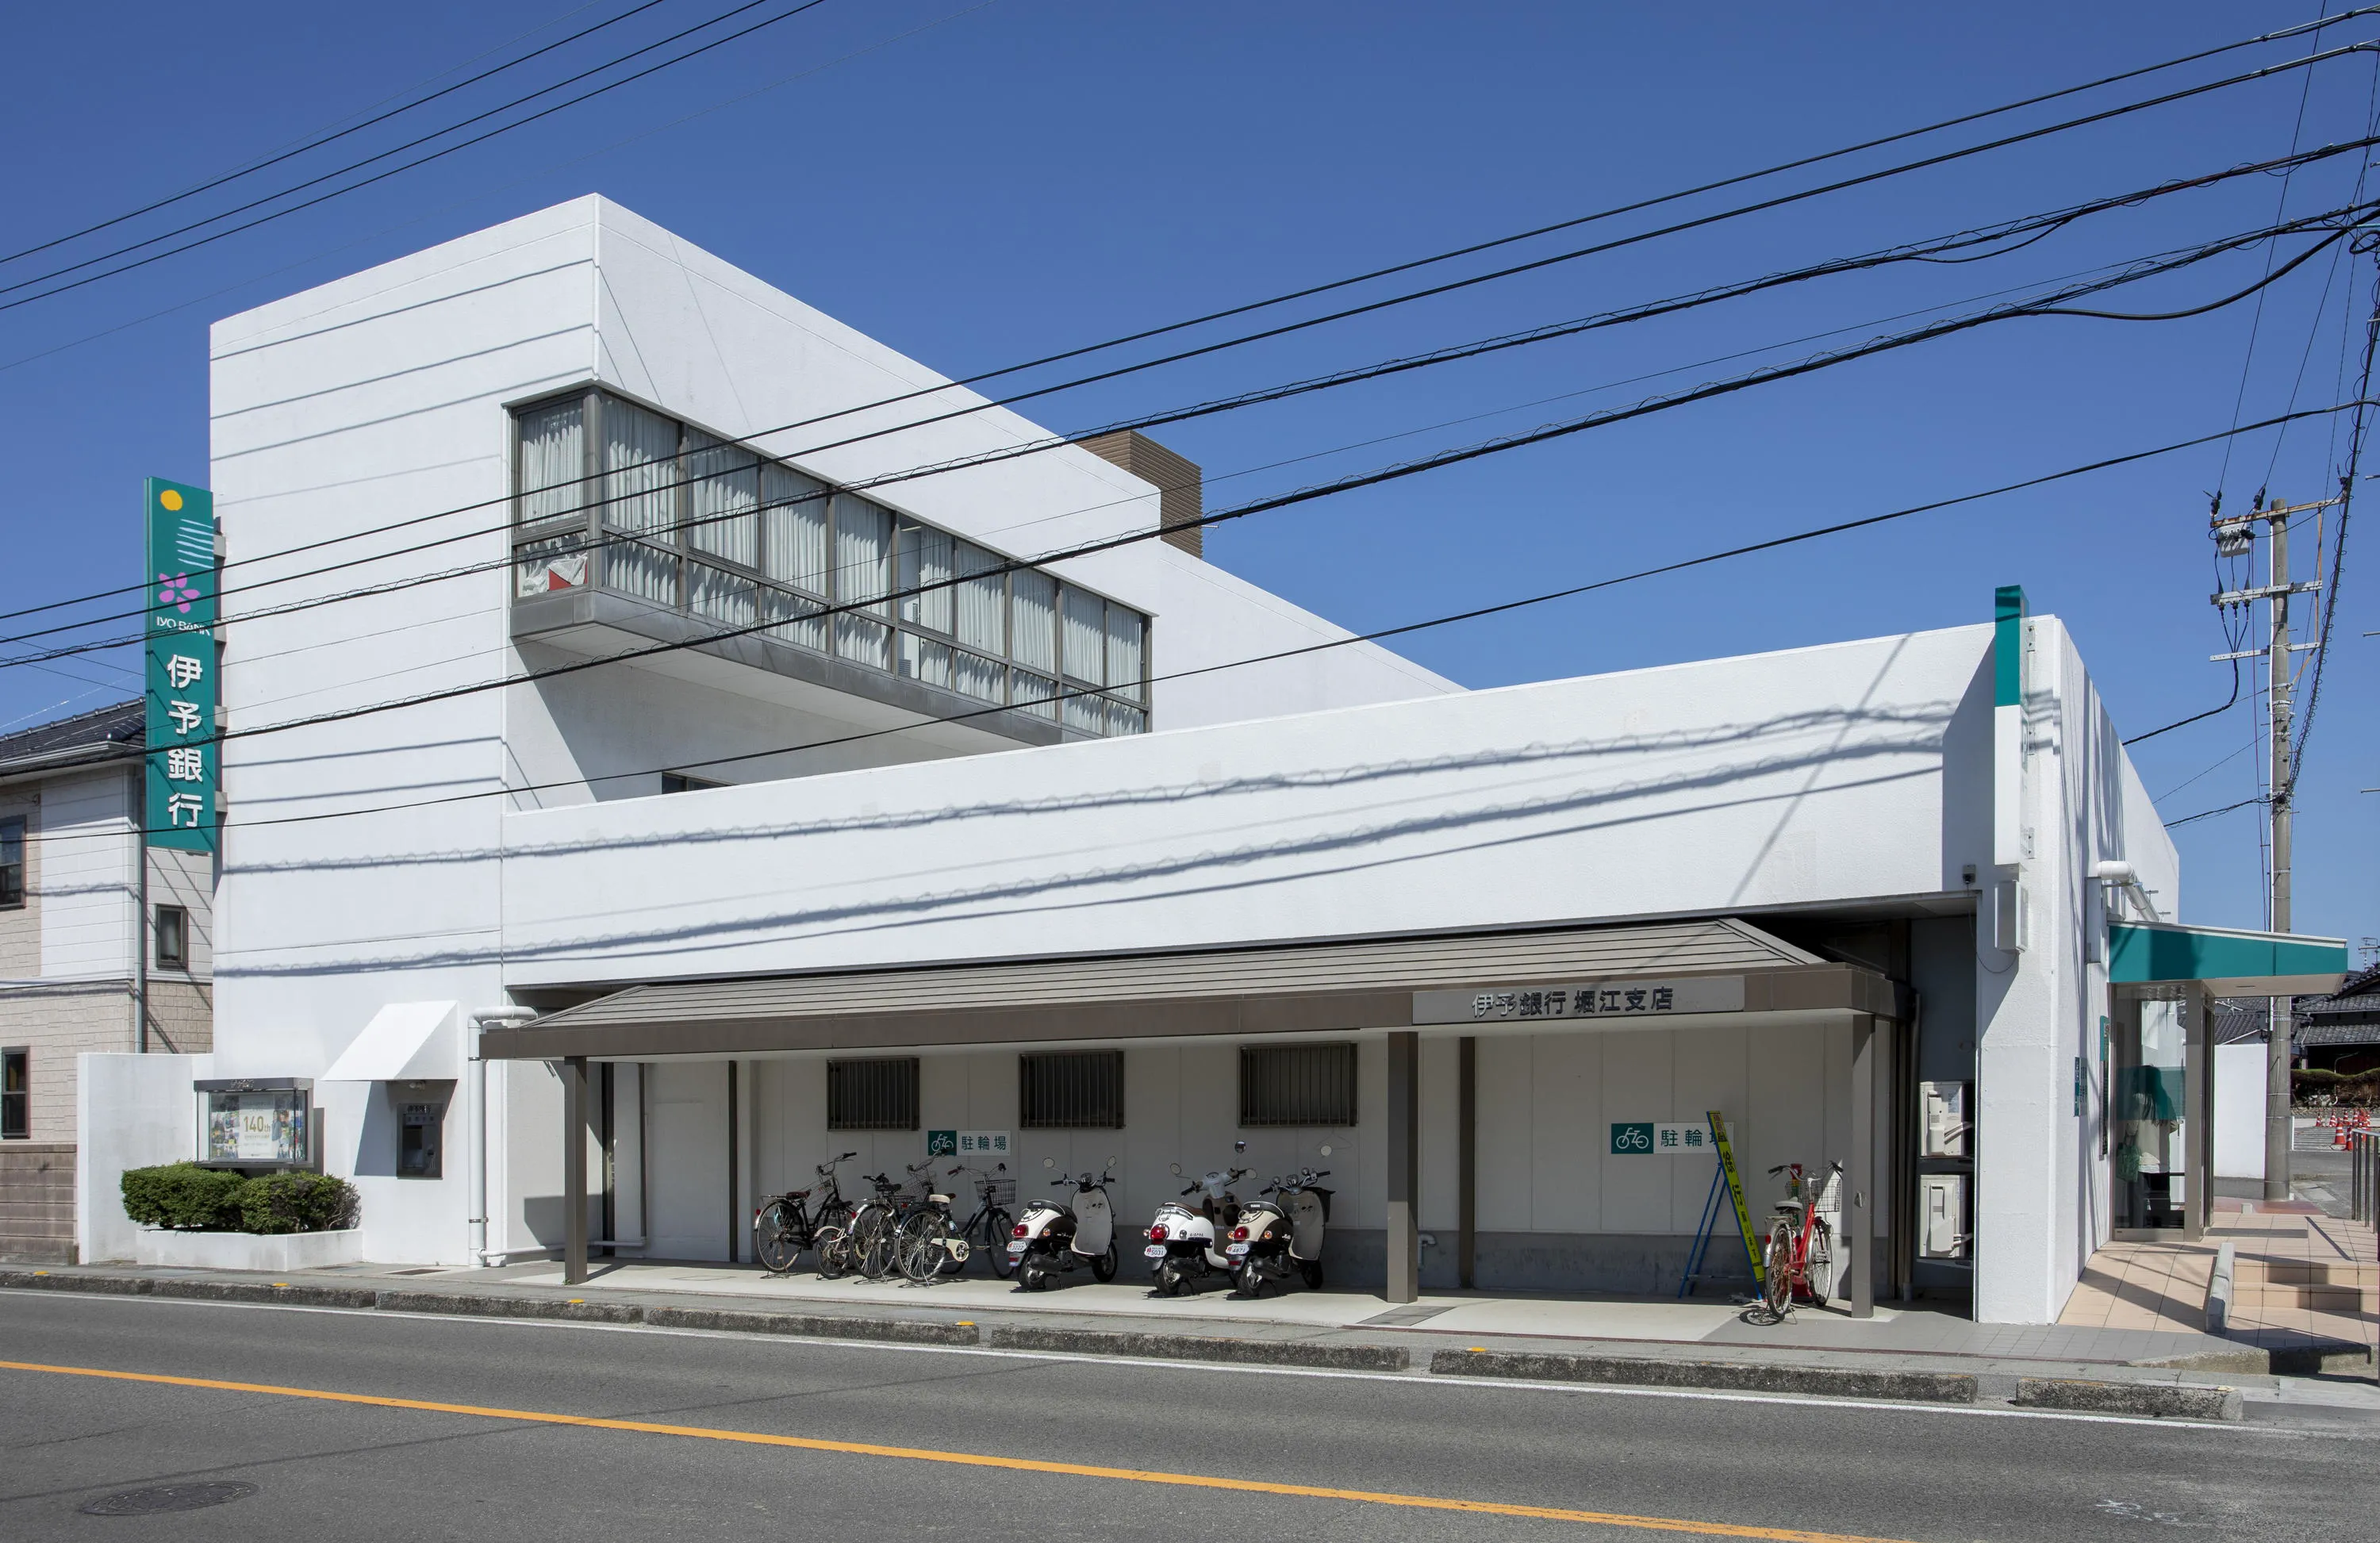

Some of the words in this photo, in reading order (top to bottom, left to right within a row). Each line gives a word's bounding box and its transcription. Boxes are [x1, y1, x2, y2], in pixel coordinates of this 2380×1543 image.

[156, 616, 176, 628] IYO
[167, 654, 203, 827] 伊予銀行
[962, 1135, 1007, 1150] 駐輪場
